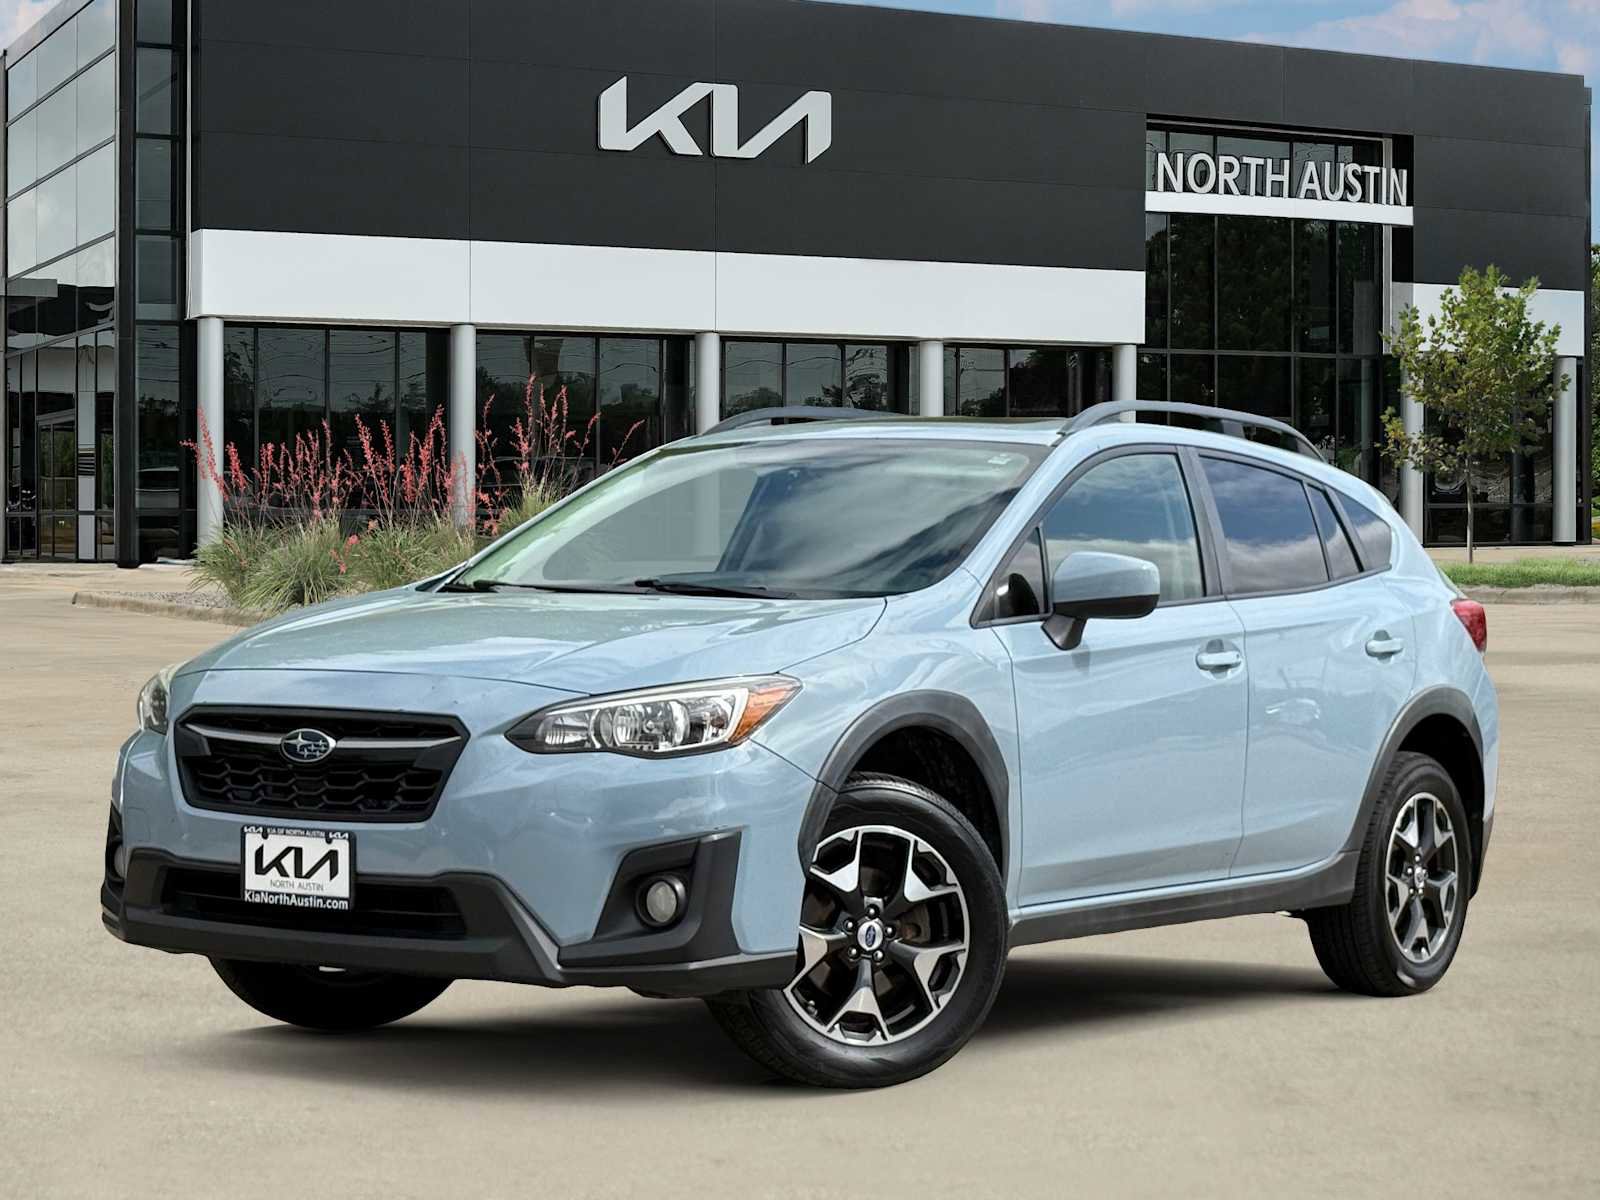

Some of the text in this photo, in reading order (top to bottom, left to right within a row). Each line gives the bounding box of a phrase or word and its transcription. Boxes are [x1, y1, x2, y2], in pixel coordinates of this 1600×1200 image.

[598, 76, 832, 164] KIA
[1157, 152, 1408, 207] NORTH AUSTIN
[305, 830, 325, 838] AUSTIN
[255, 844, 339, 882] KIA
[244, 890, 349, 910] KiaNorthAustin.com
[270, 879, 324, 892] NORTH AUSTIN
